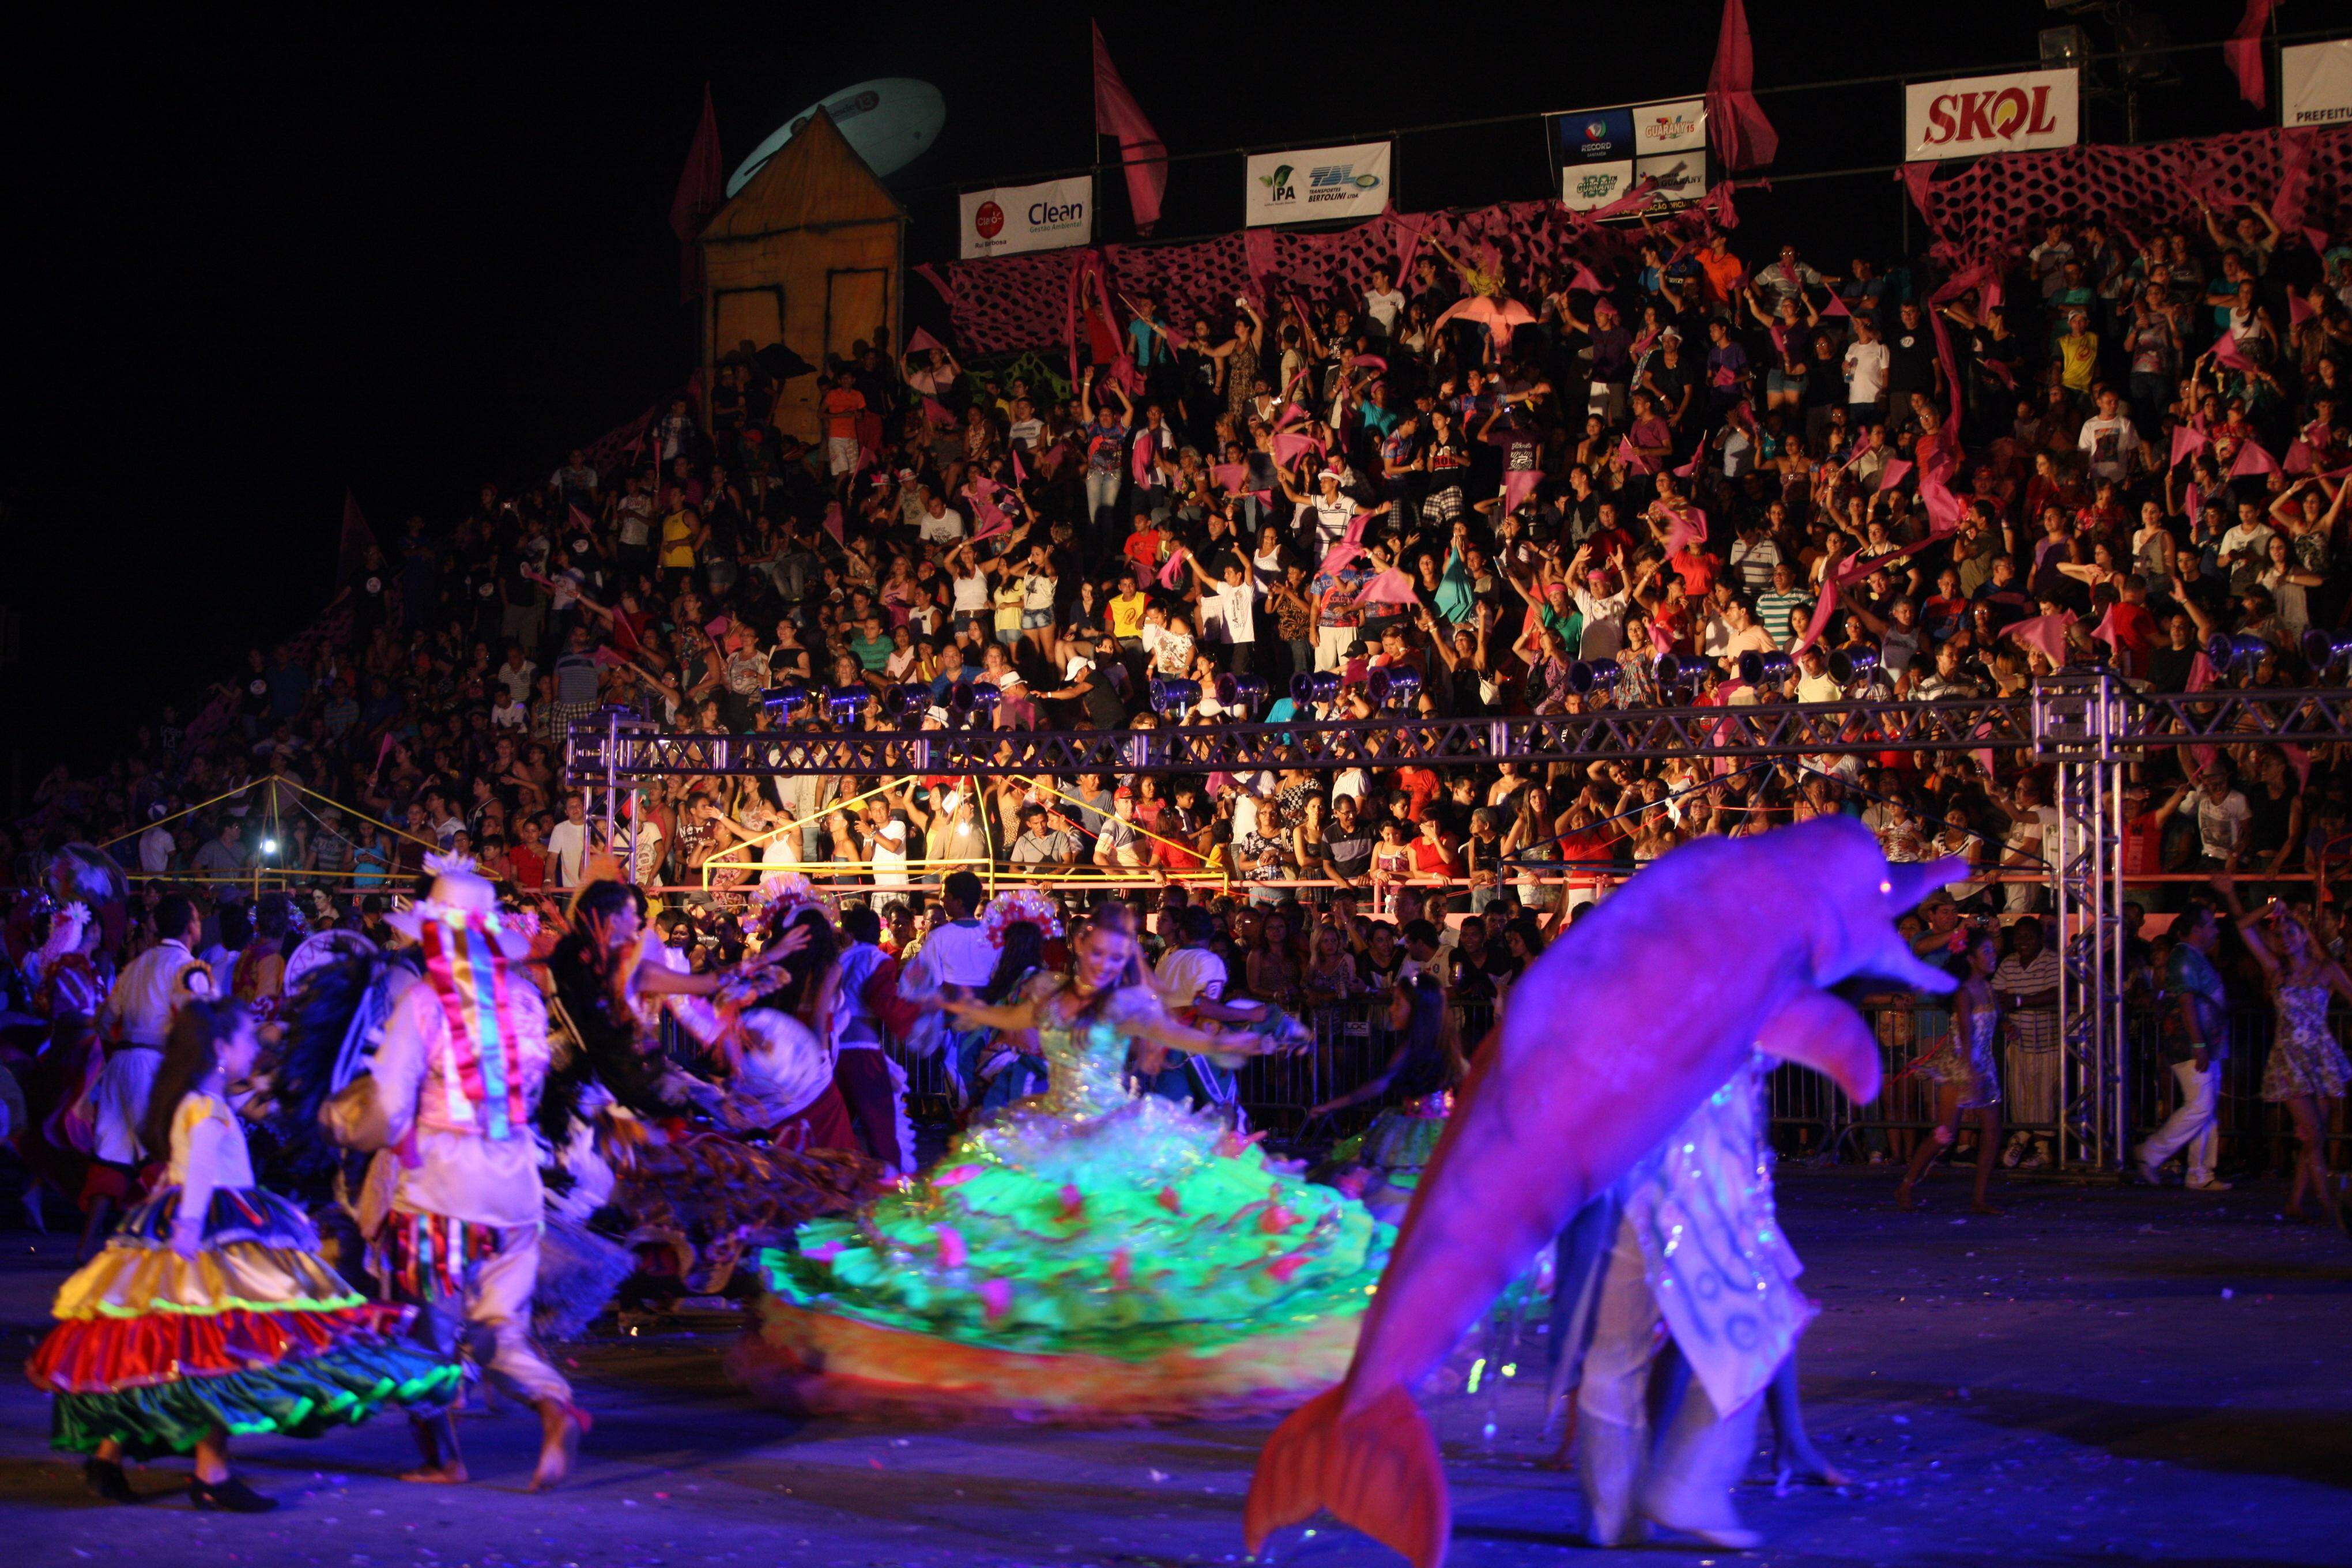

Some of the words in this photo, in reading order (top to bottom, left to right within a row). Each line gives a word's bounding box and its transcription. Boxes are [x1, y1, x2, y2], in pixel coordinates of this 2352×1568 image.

[1923, 85, 2057, 145] SKOL
[1645, 121, 1686, 138] GUARANY
[1687, 124, 1695, 133] 15
[1581, 141, 1612, 152] RECORD
[1308, 192, 1347, 203] BERTOLINI
[1028, 202, 1083, 225] Clean
[977, 216, 998, 227] Claro
[1051, 221, 1081, 231] Ambiental
